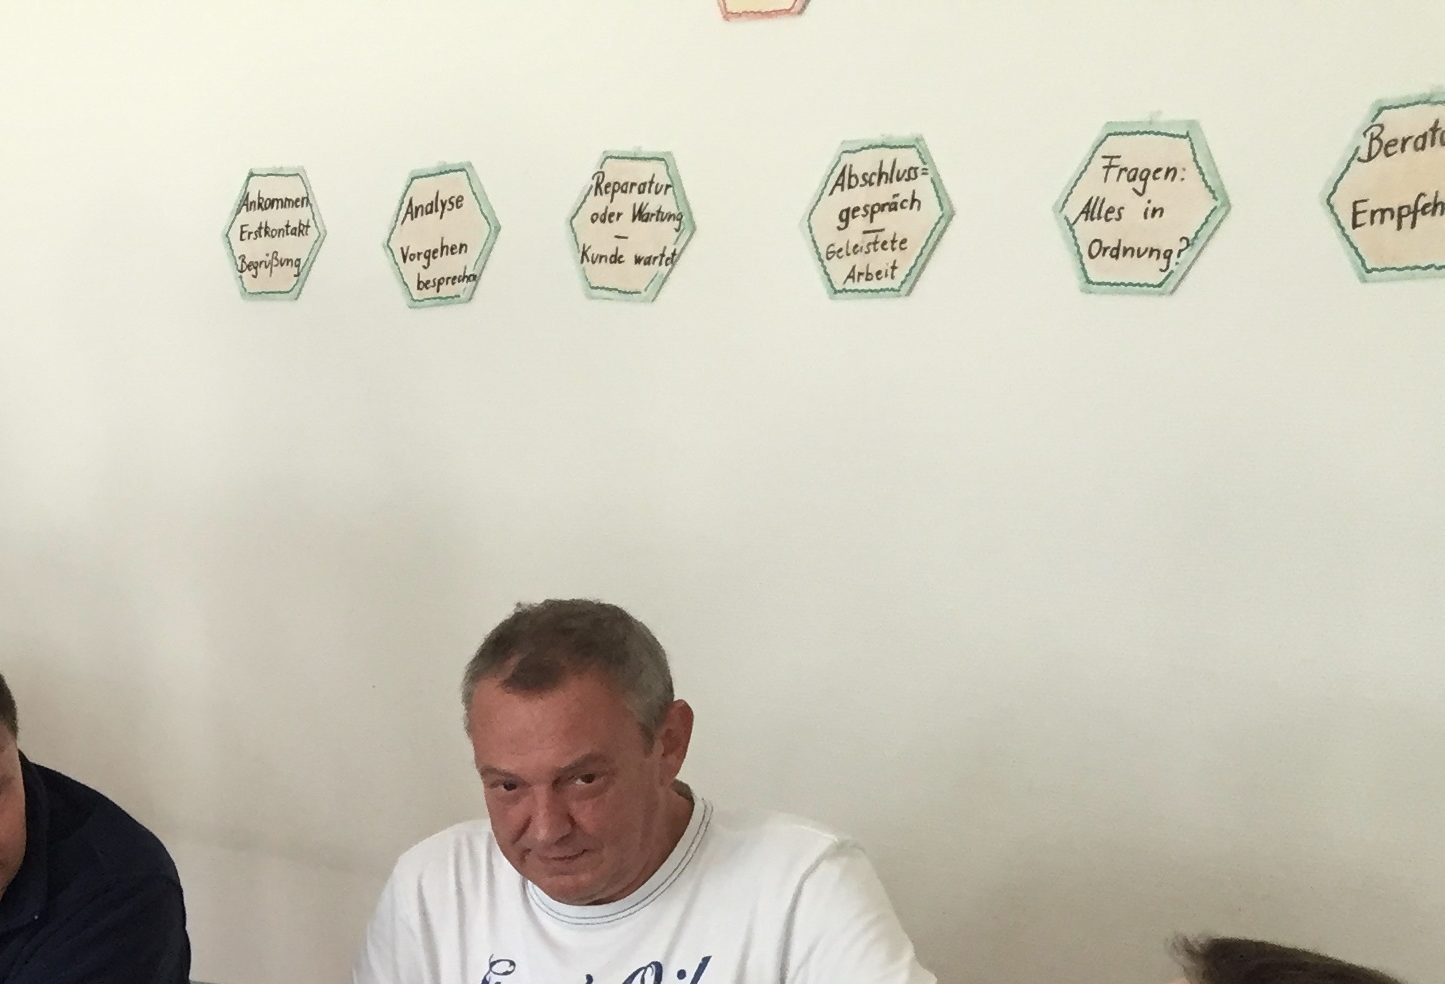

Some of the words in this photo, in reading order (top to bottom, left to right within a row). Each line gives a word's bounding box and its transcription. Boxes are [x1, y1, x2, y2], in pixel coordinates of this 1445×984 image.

[592, 171, 673, 203] Reparatur
[1101, 155, 1186, 197] Fragen:
[241, 190, 309, 212] Ankommen
[401, 189, 464, 225] Analyse
[836, 189, 922, 231] gespräch
[1071, 196, 1125, 227] Alles
[1143, 199, 1165, 220] in
[239, 219, 311, 241] Erstkontakt
[590, 205, 623, 224] oder
[632, 202, 683, 232] Wartung
[400, 236, 468, 269] Vorgehen
[580, 243, 625, 264] Kunde
[634, 245, 677, 267] wartet
[825, 232, 908, 261] Geleistete
[1087, 236, 1191, 272] Ordnung?
[238, 251, 301, 278] Begrüßung
[843, 259, 898, 285] Arbeit
